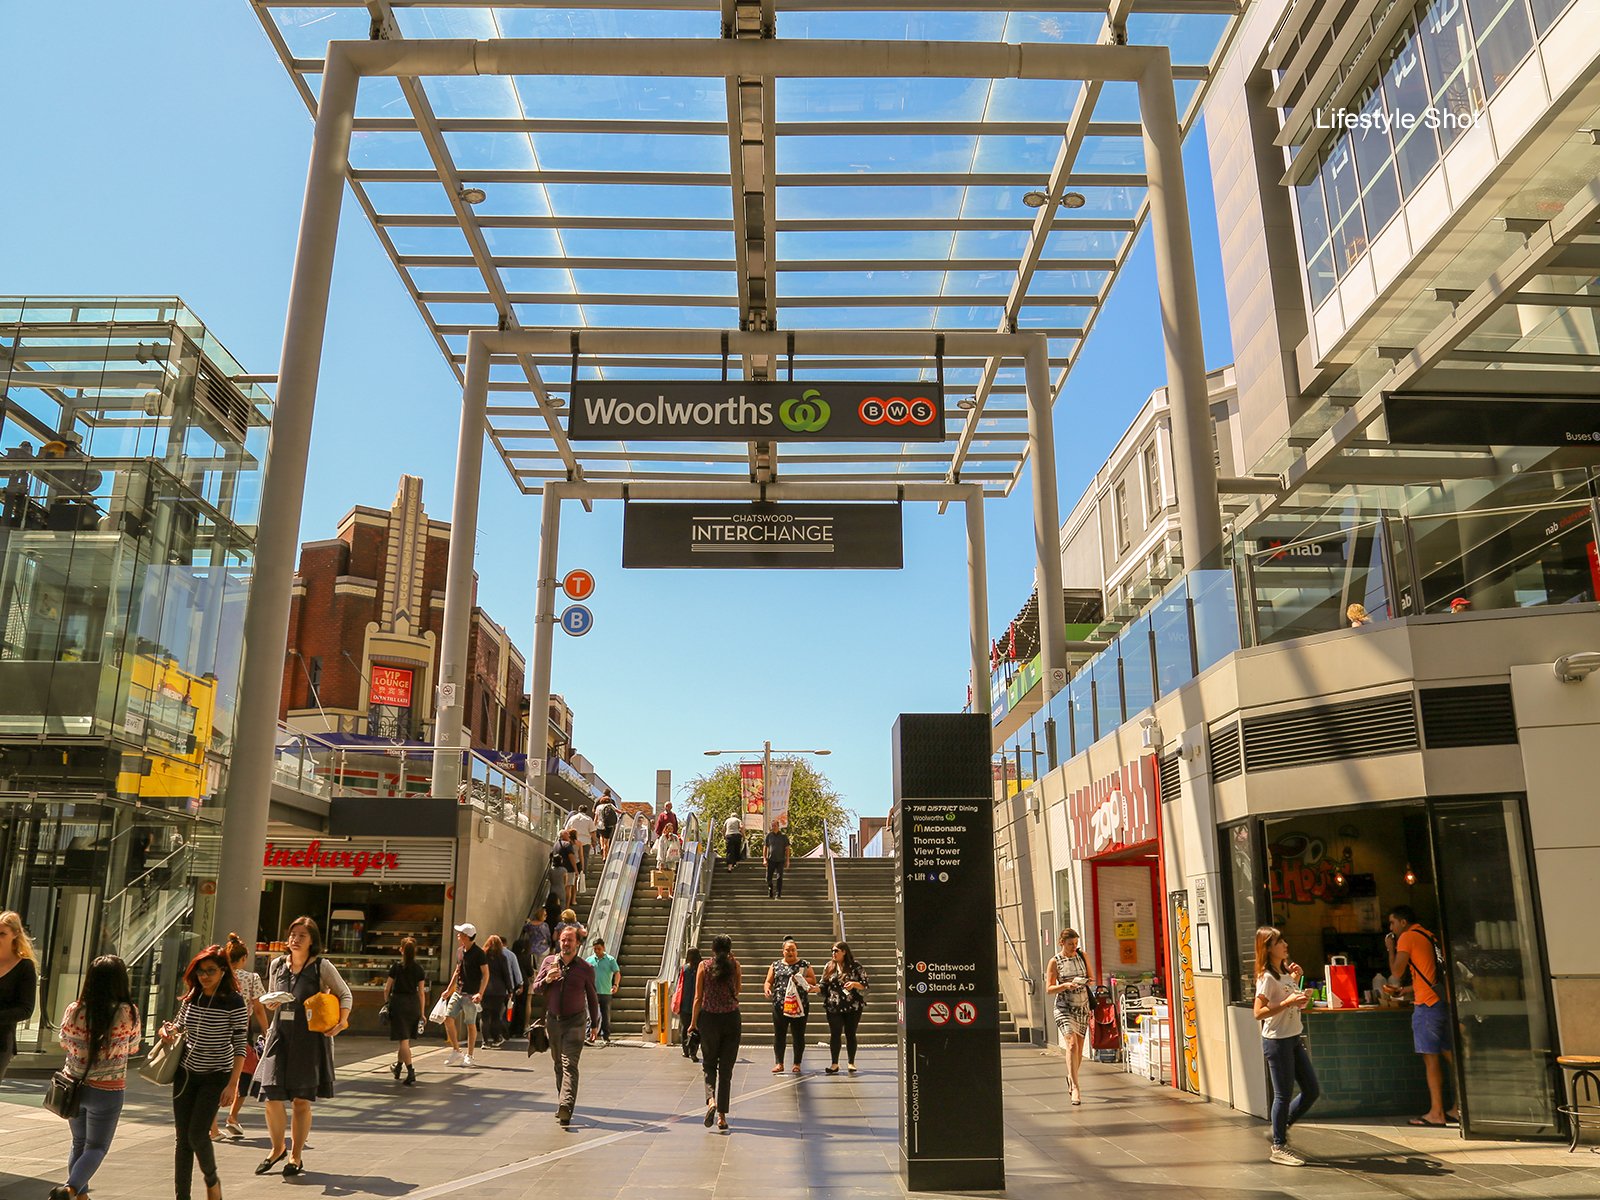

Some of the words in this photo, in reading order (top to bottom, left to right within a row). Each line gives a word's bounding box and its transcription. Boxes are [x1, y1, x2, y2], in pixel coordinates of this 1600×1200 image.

[584, 395, 774, 425] Woolworths
[1566, 431, 1592, 441] Buses
[732, 514, 794, 523] CHATSWOOD
[691, 525, 834, 541] INTERCHANGE
[1545, 521, 1559, 536] nab
[1290, 543, 1322, 556] nab
[572, 577, 585, 594] T
[1401, 593, 1412, 610] ab
[570, 612, 583, 629] B
[384, 670, 401, 680] VIP
[375, 677, 409, 689] LOUNGE
[913, 836, 945, 844] Thomas
[946, 837, 957, 845] St.
[913, 847, 934, 855] View
[935, 847, 960, 855] Tower
[263, 840, 400, 877] ineburger
[913, 858, 935, 867] Spire
[935, 858, 961, 866] Tower
[914, 873, 926, 881] Lift
[927, 963, 976, 971] Chatswood
[927, 972, 957, 980] Station
[928, 983, 957, 991] Stands
[911, 1073, 920, 1122] CHATSWOOD
